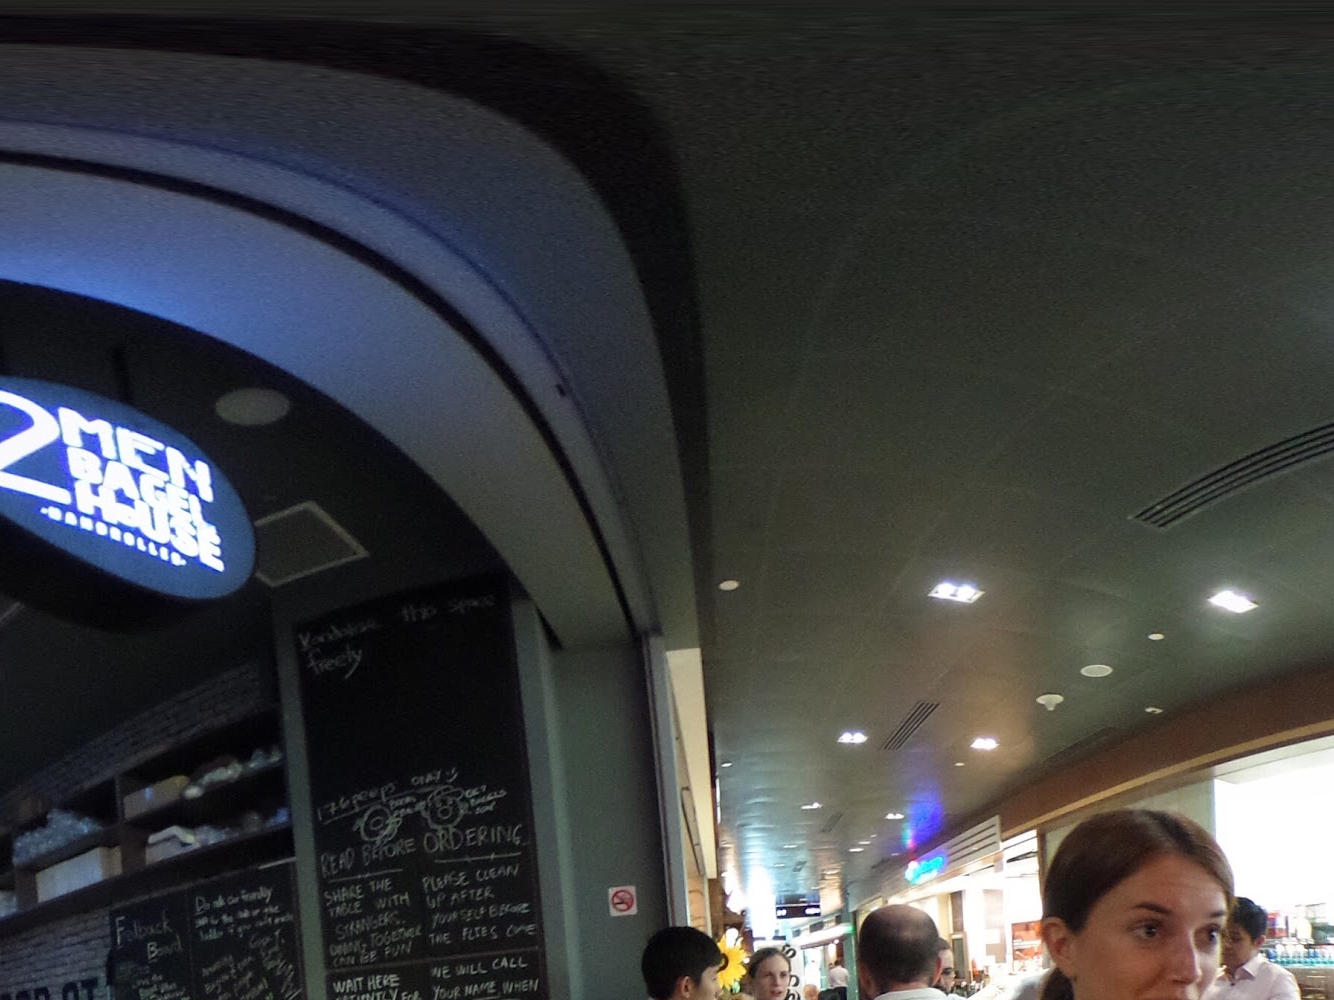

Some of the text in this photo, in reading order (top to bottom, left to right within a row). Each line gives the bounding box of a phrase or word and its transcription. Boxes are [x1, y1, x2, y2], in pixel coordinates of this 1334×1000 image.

[58, 406, 213, 502] MEN
[67, 447, 209, 533] BAGEL
[75, 479, 224, 572] HOUSE
[320, 847, 355, 879] READ
[423, 824, 523, 852] ORDERING
[422, 863, 519, 894] PLEASE CLEAN
[323, 878, 393, 907] SHARE THE
[328, 891, 411, 917] TABLE WITH
[426, 885, 495, 909] UP AFTER
[370, 924, 422, 947] TOGETHER
[428, 931, 451, 946] THE
[462, 925, 498, 940] FLIES
[333, 940, 412, 967] CAN BE FUN
[431, 956, 529, 979] WE WILL CALL
[332, 973, 402, 993] WAIT HERE
[465, 981, 496, 997] NAME
[502, 978, 540, 994] WHEN
